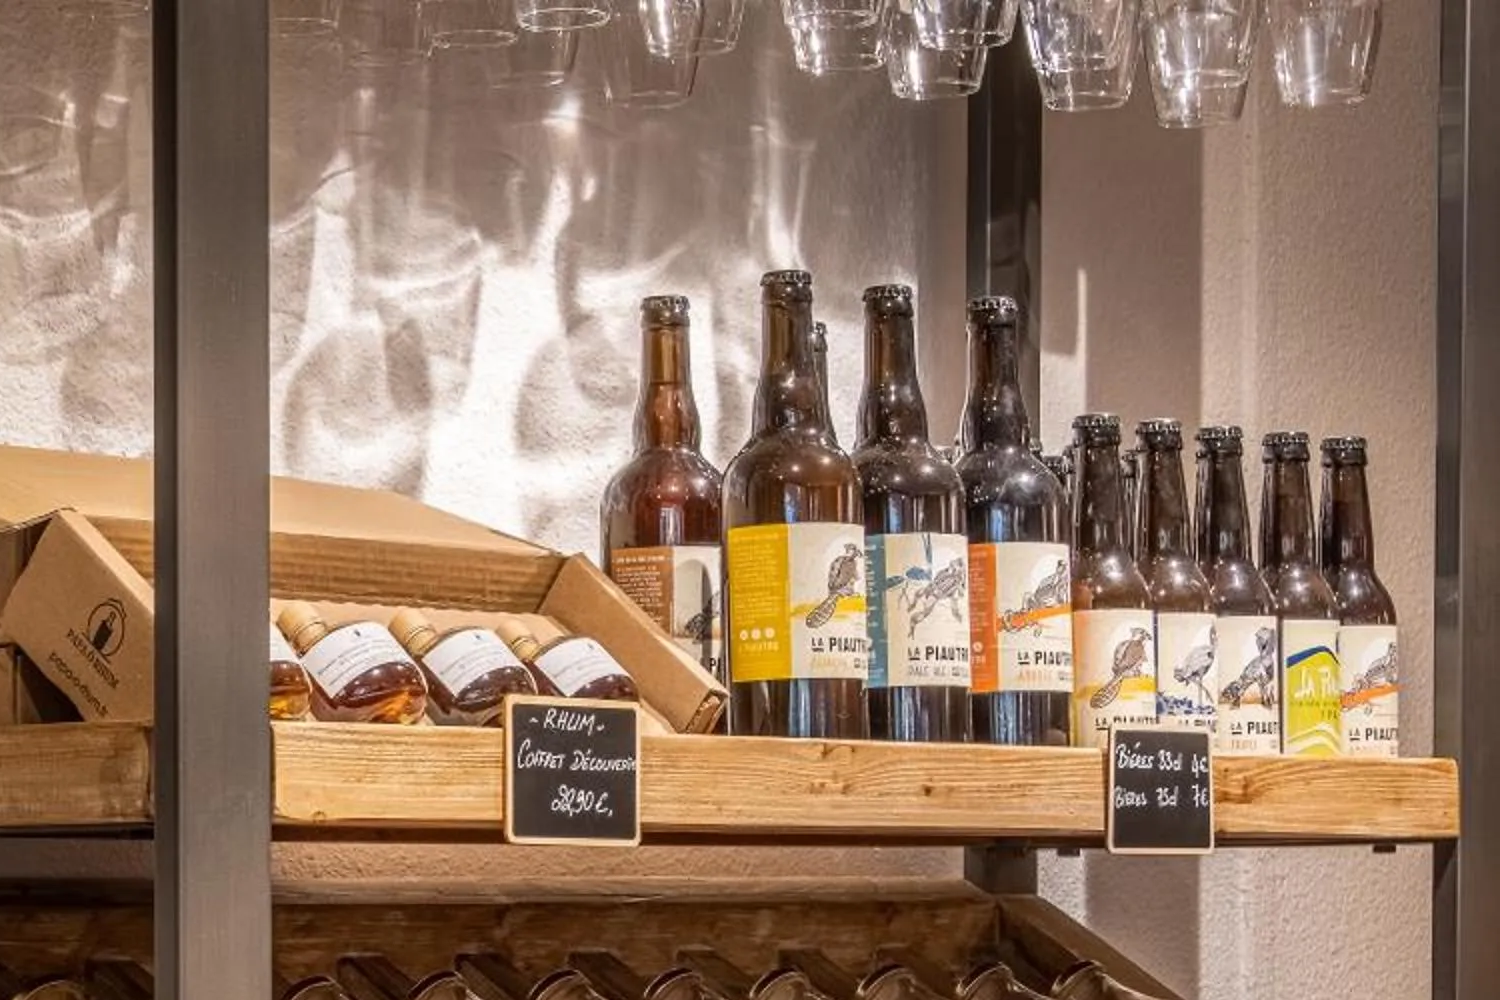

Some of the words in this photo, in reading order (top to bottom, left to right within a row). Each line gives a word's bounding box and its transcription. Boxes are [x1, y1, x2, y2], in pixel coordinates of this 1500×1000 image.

[812, 638, 825, 651] LA
[908, 648, 921, 660] LA
[925, 646, 968, 661] PIAUTR
[1017, 652, 1031, 665] LA
